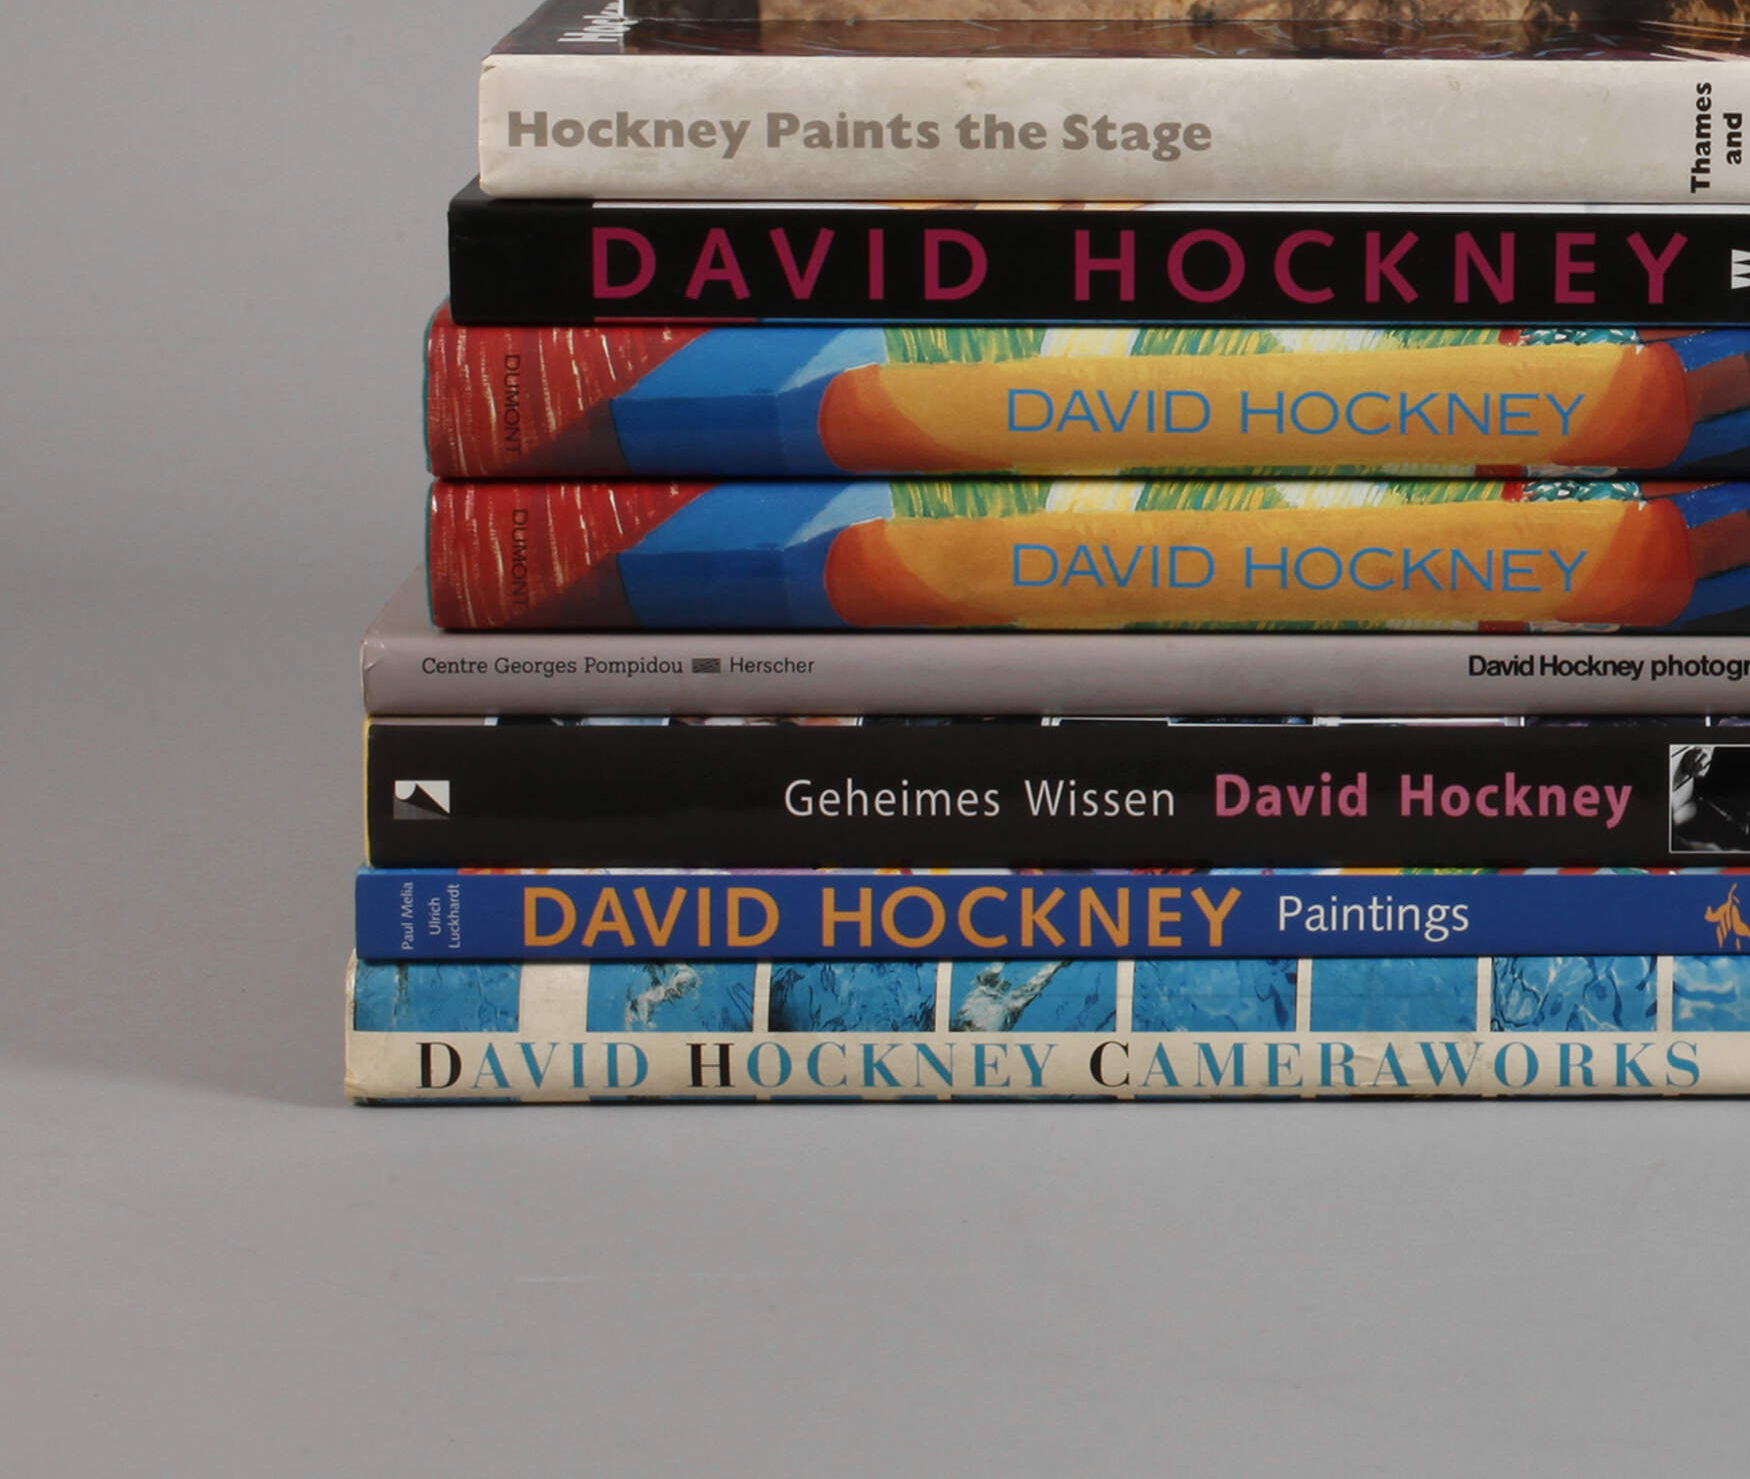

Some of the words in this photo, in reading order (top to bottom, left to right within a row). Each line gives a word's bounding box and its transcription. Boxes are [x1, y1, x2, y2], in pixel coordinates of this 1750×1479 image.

[507, 110, 751, 159] Hockney
[766, 111, 939, 151] Paints
[955, 112, 1047, 151] the
[1062, 112, 1212, 162] Stage
[1691, 81, 1712, 193] Thames
[1726, 111, 1743, 165] and
[592, 227, 988, 300] DAVID
[1074, 229, 1688, 304] HOCKNEY
[504, 354, 522, 455] DUMONT
[1008, 389, 1211, 433] DAVID
[1240, 390, 1586, 436] HOCKNEY
[512, 509, 529, 608] DUMONT
[1011, 544, 1215, 589] DAVID
[1245, 546, 1588, 593] HOCKNEY
[421, 656, 488, 675] Centre
[494, 656, 577, 678] Georges
[584, 655, 683, 678] Pompidou
[729, 656, 814, 674] Herscher
[1468, 655, 1535, 677] David
[1539, 655, 1644, 681] Hockney
[785, 779, 1000, 817] Geheimes
[1025, 779, 1174, 817] Wissen
[1214, 773, 1369, 817] David
[1400, 774, 1633, 829] Hockney
[400, 881, 414, 917] Melia
[428, 896, 441, 935] Ulrich
[446, 883, 460, 949] Luckhardt
[523, 887, 780, 948] DAVID
[823, 887, 1241, 948] HOCKNEY
[1279, 895, 1469, 942] Paintings
[400, 922, 414, 950] Paul
[417, 1041, 649, 1089] DAVID
[686, 1041, 1058, 1089] HOCKNEY
[1088, 1039, 1702, 1089] CAMERAWORKS
